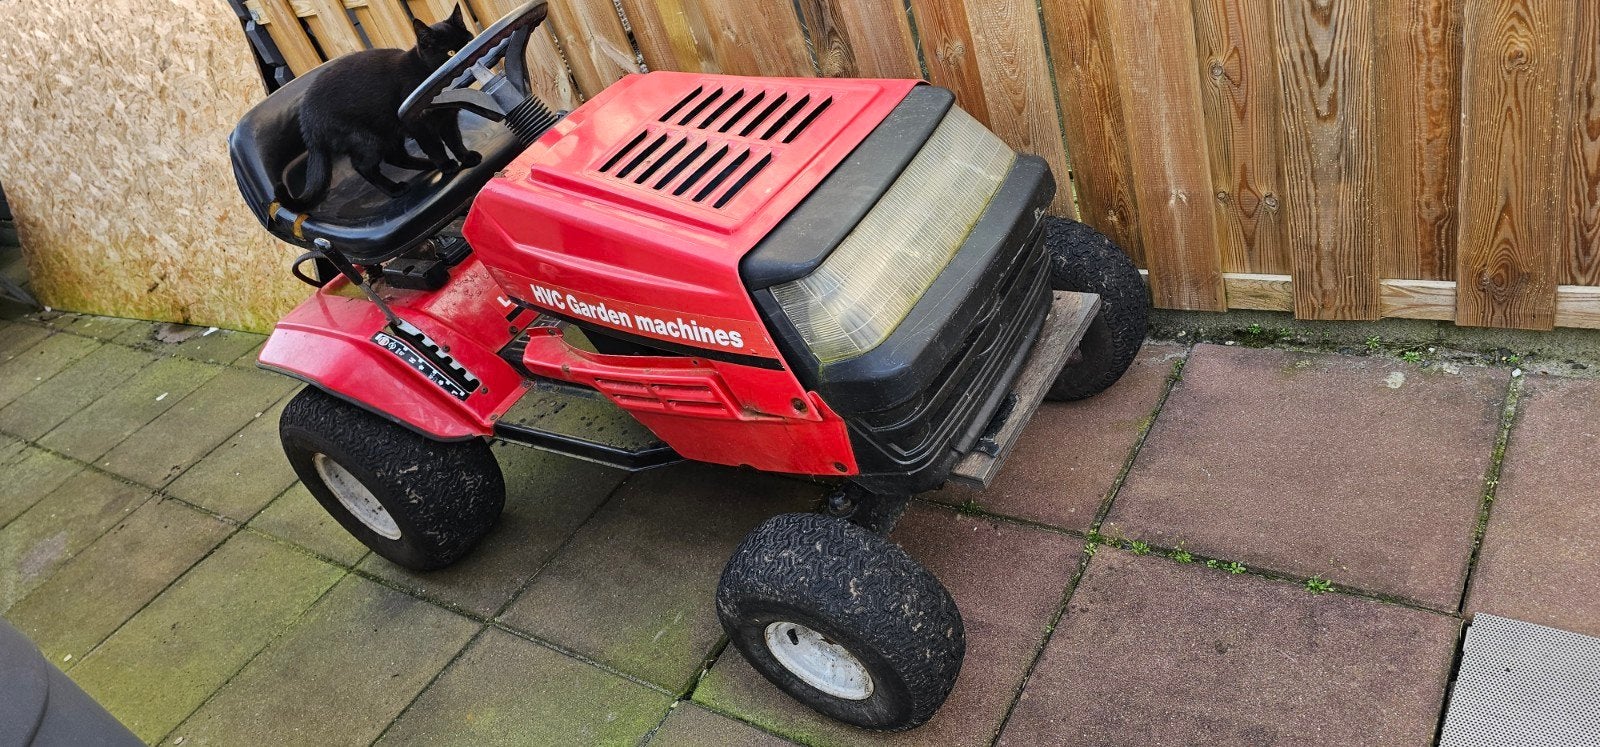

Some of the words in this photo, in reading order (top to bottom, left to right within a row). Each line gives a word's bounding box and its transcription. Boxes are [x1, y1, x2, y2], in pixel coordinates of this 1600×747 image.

[530, 283, 566, 310] HVC
[566, 294, 633, 328] Garden
[634, 314, 744, 348] machines
